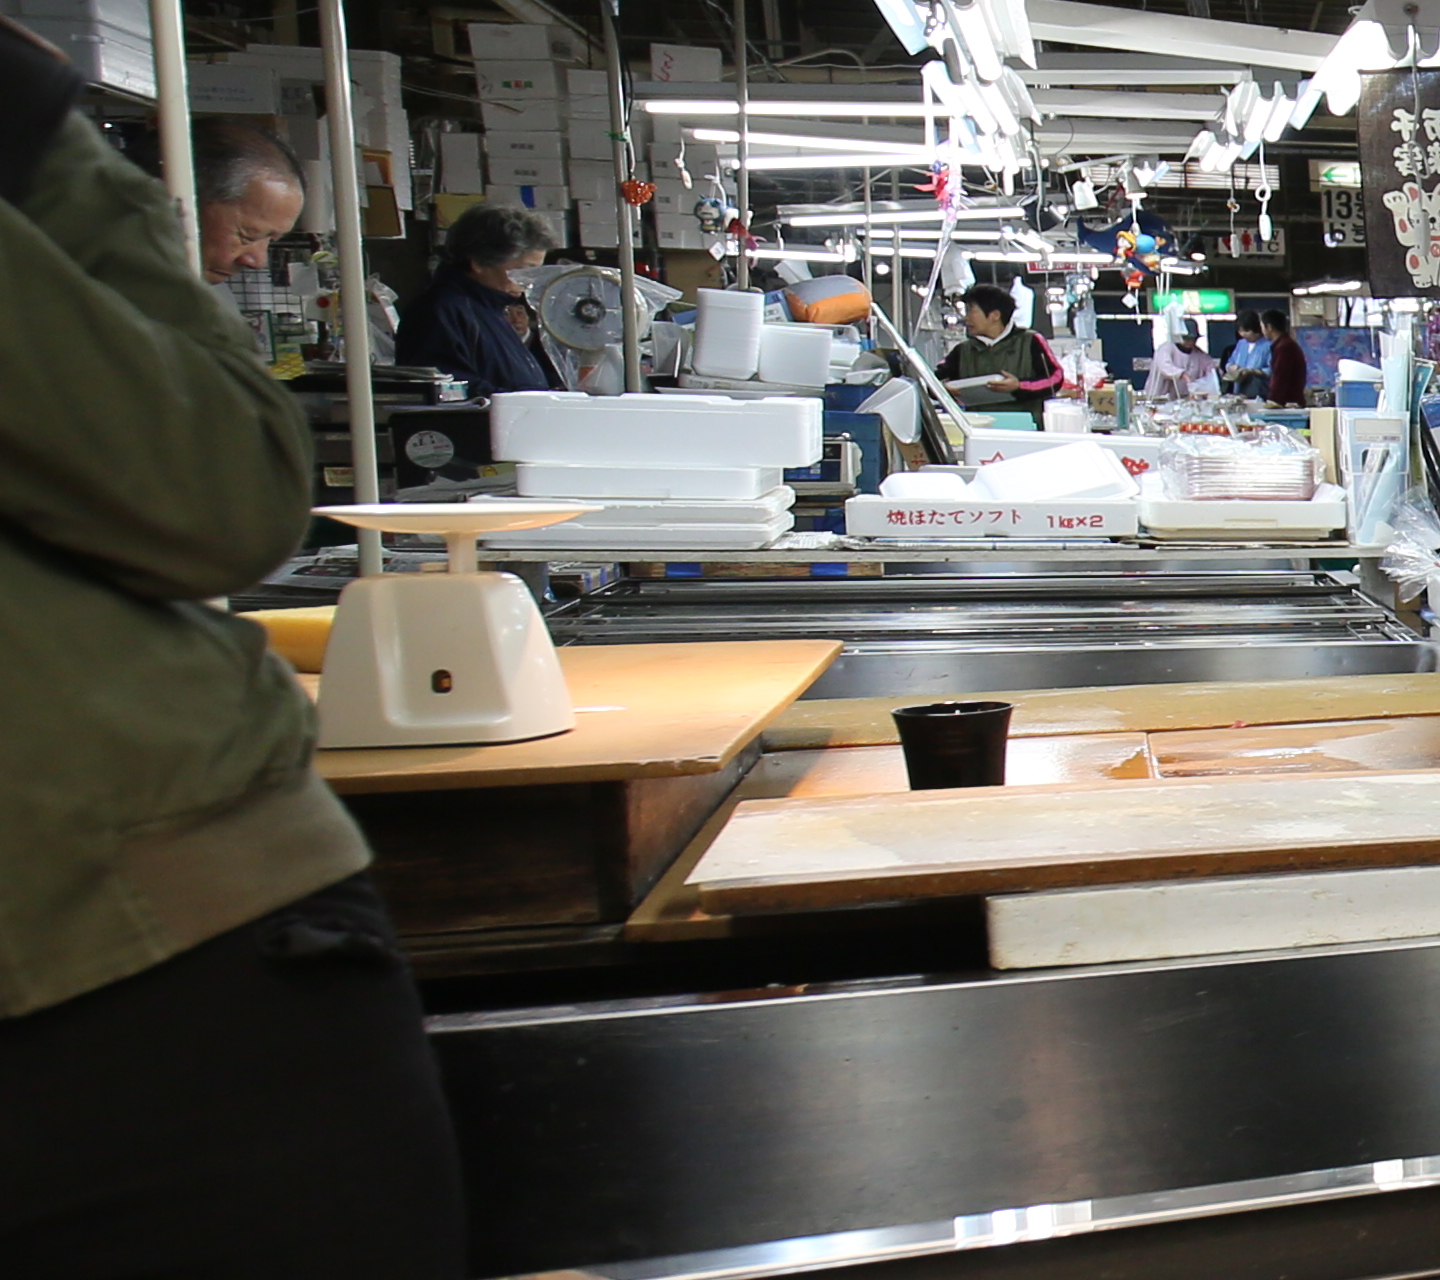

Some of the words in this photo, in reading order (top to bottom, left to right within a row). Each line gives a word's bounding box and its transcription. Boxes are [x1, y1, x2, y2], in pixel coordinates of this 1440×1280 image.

[886, 508, 1023, 526] 焼ほたてソフト
